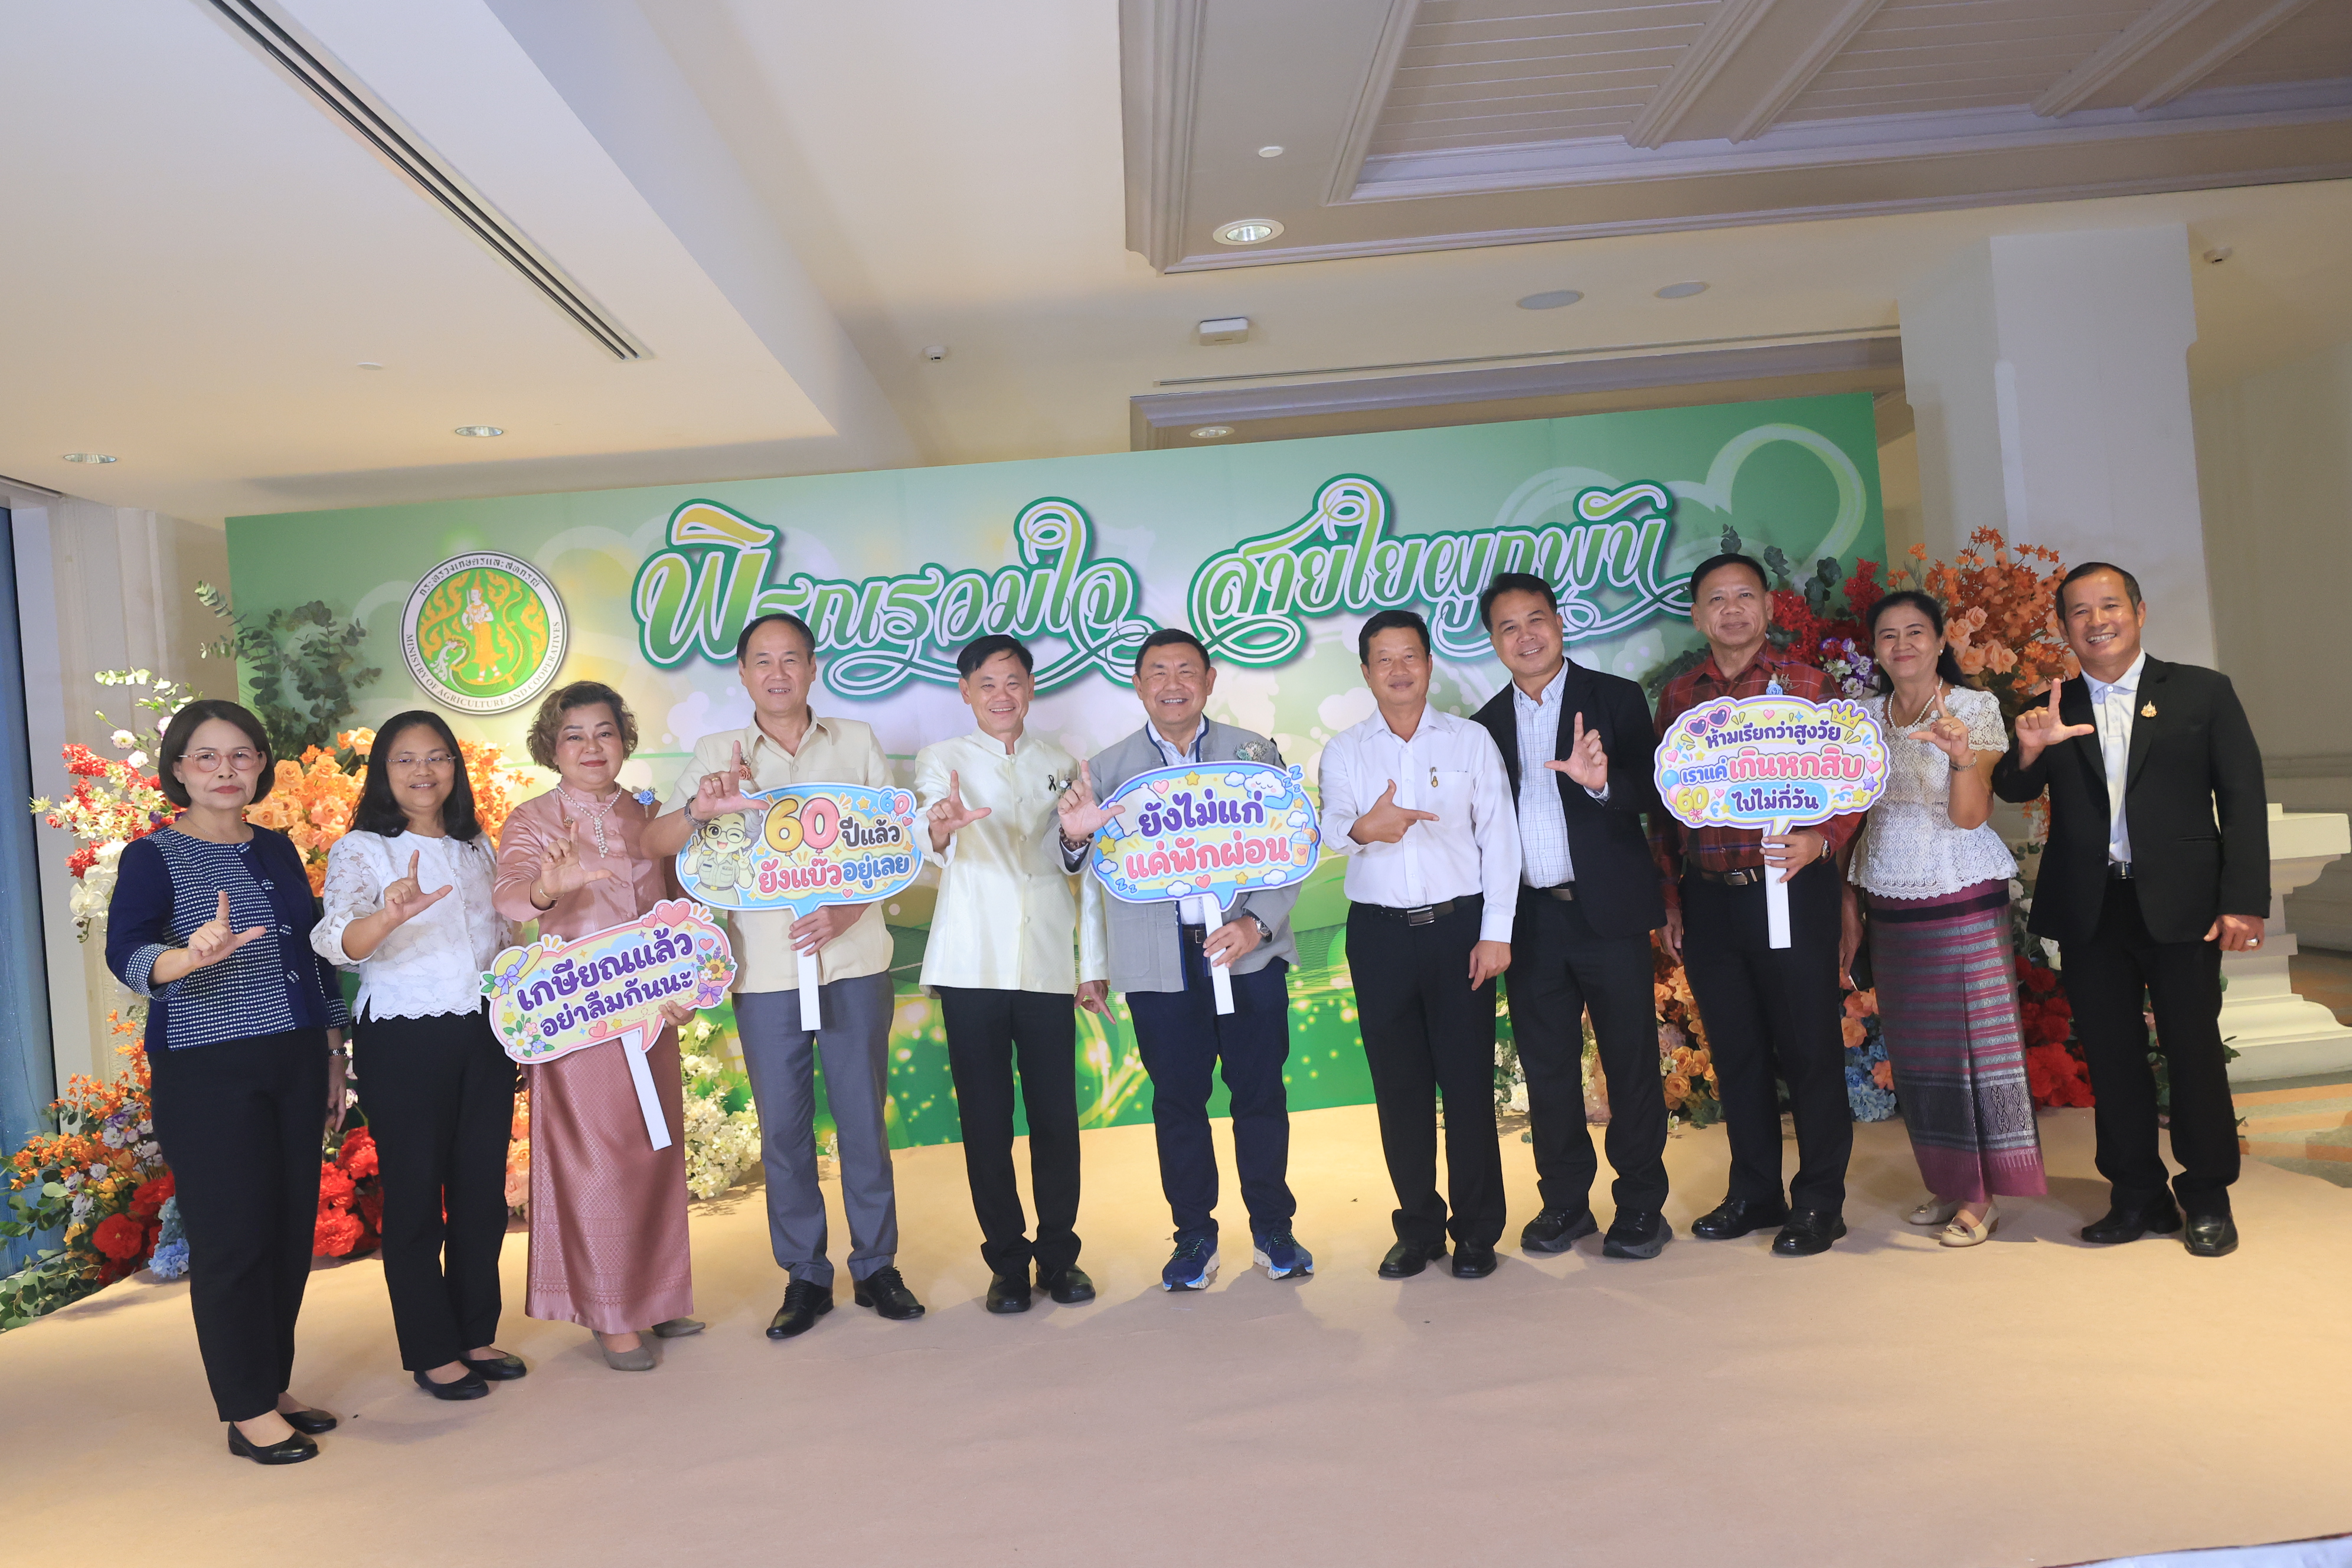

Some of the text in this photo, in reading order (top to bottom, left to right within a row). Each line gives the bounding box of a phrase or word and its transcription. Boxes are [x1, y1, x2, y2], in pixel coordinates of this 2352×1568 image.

[635, 498, 1158, 698] พิรณรวมใจ
[406, 621, 560, 708] MINISTRY OF AGRICULTURE AND COOPERATIVES
[1706, 720, 1841, 749] ห้ามเรียกว่าสูงวัย
[879, 792, 910, 815] 60
[1138, 788, 1264, 837] ยังไม่แก่
[1675, 786, 1709, 812] 60
[1732, 783, 1819, 812] ไปไม่กี่วัน
[765, 797, 901, 852] 60 ปีแล้ว
[1125, 830, 1291, 879] แค่พักผ่อน
[517, 927, 694, 1011] เกษียณแล้ว
[540, 971, 694, 1037] อย่าลืมกันนะ
